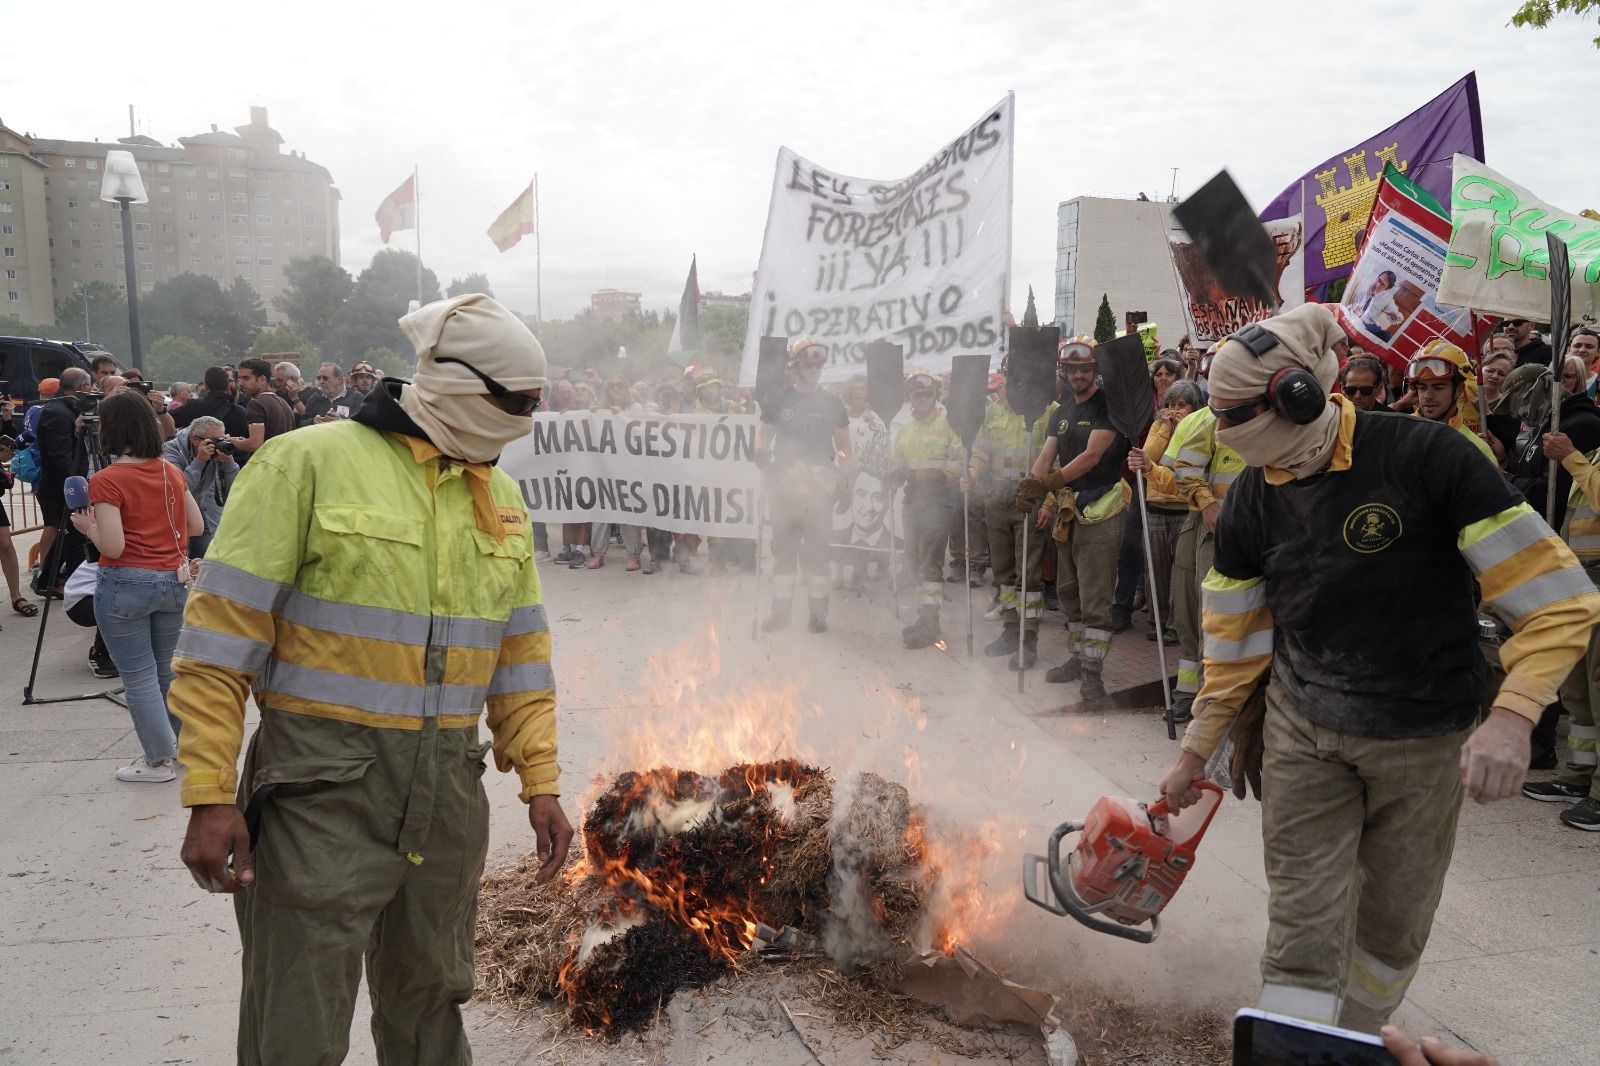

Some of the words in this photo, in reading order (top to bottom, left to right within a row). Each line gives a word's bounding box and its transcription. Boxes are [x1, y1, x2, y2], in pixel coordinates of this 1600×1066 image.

[786, 158, 852, 205] LEY
[1386, 255, 1397, 264] año
[1403, 266, 1424, 281] absurdo
[1427, 281, 1436, 289] un
[1390, 239, 1403, 250] Juan
[1403, 246, 1421, 260] Carlos
[1419, 256, 1443, 277] Suárez-Q
[1410, 260, 1436, 279] operativo
[533, 418, 618, 455] MALA
[624, 415, 756, 462] GESTIÓN
[519, 468, 648, 514] UIÑONES
[652, 483, 754, 525] DIMISI
